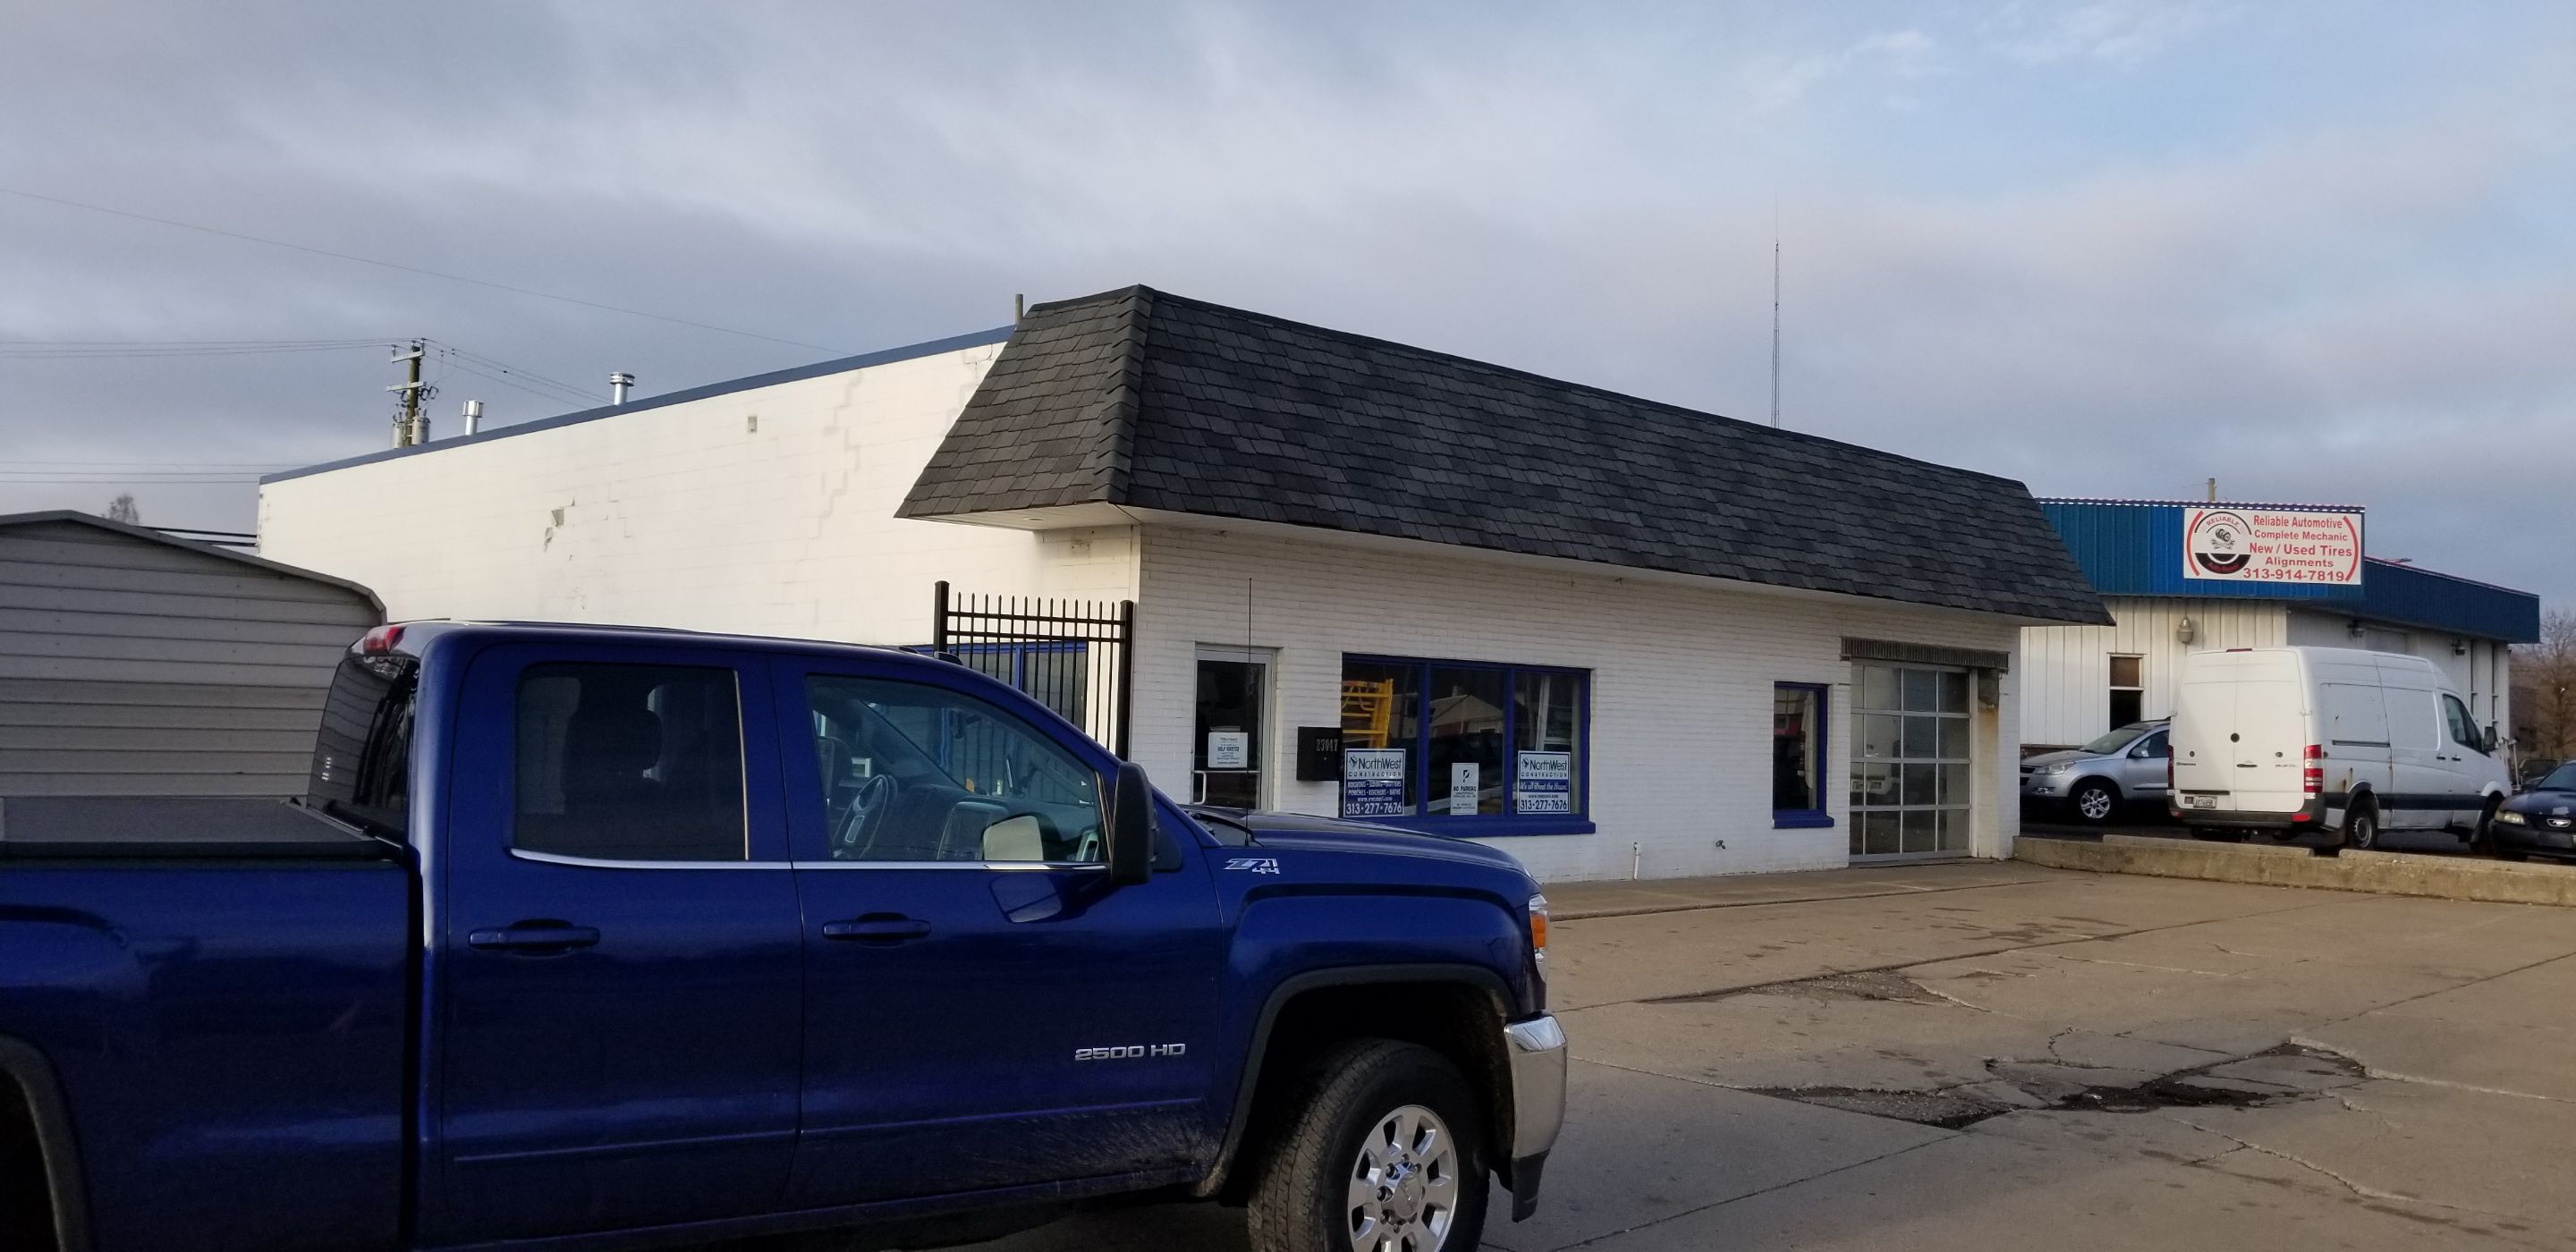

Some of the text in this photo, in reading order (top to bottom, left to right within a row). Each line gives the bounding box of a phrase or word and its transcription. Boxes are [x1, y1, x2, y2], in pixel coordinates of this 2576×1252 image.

[2253, 515, 2343, 529] Reliable Automotive
[2254, 529, 2348, 542] Complete Mechanic
[2250, 543, 2274, 554] New
[2284, 544, 2316, 555] Used
[2320, 545, 2352, 557] Tires
[2266, 556, 2334, 568] Alignments
[2243, 568, 2344, 582] 313-914-7819
[1358, 757, 1402, 770] NorthWest
[1530, 759, 1567, 771] NorthWest
[1074, 1043, 1186, 1062] 2500 HD
